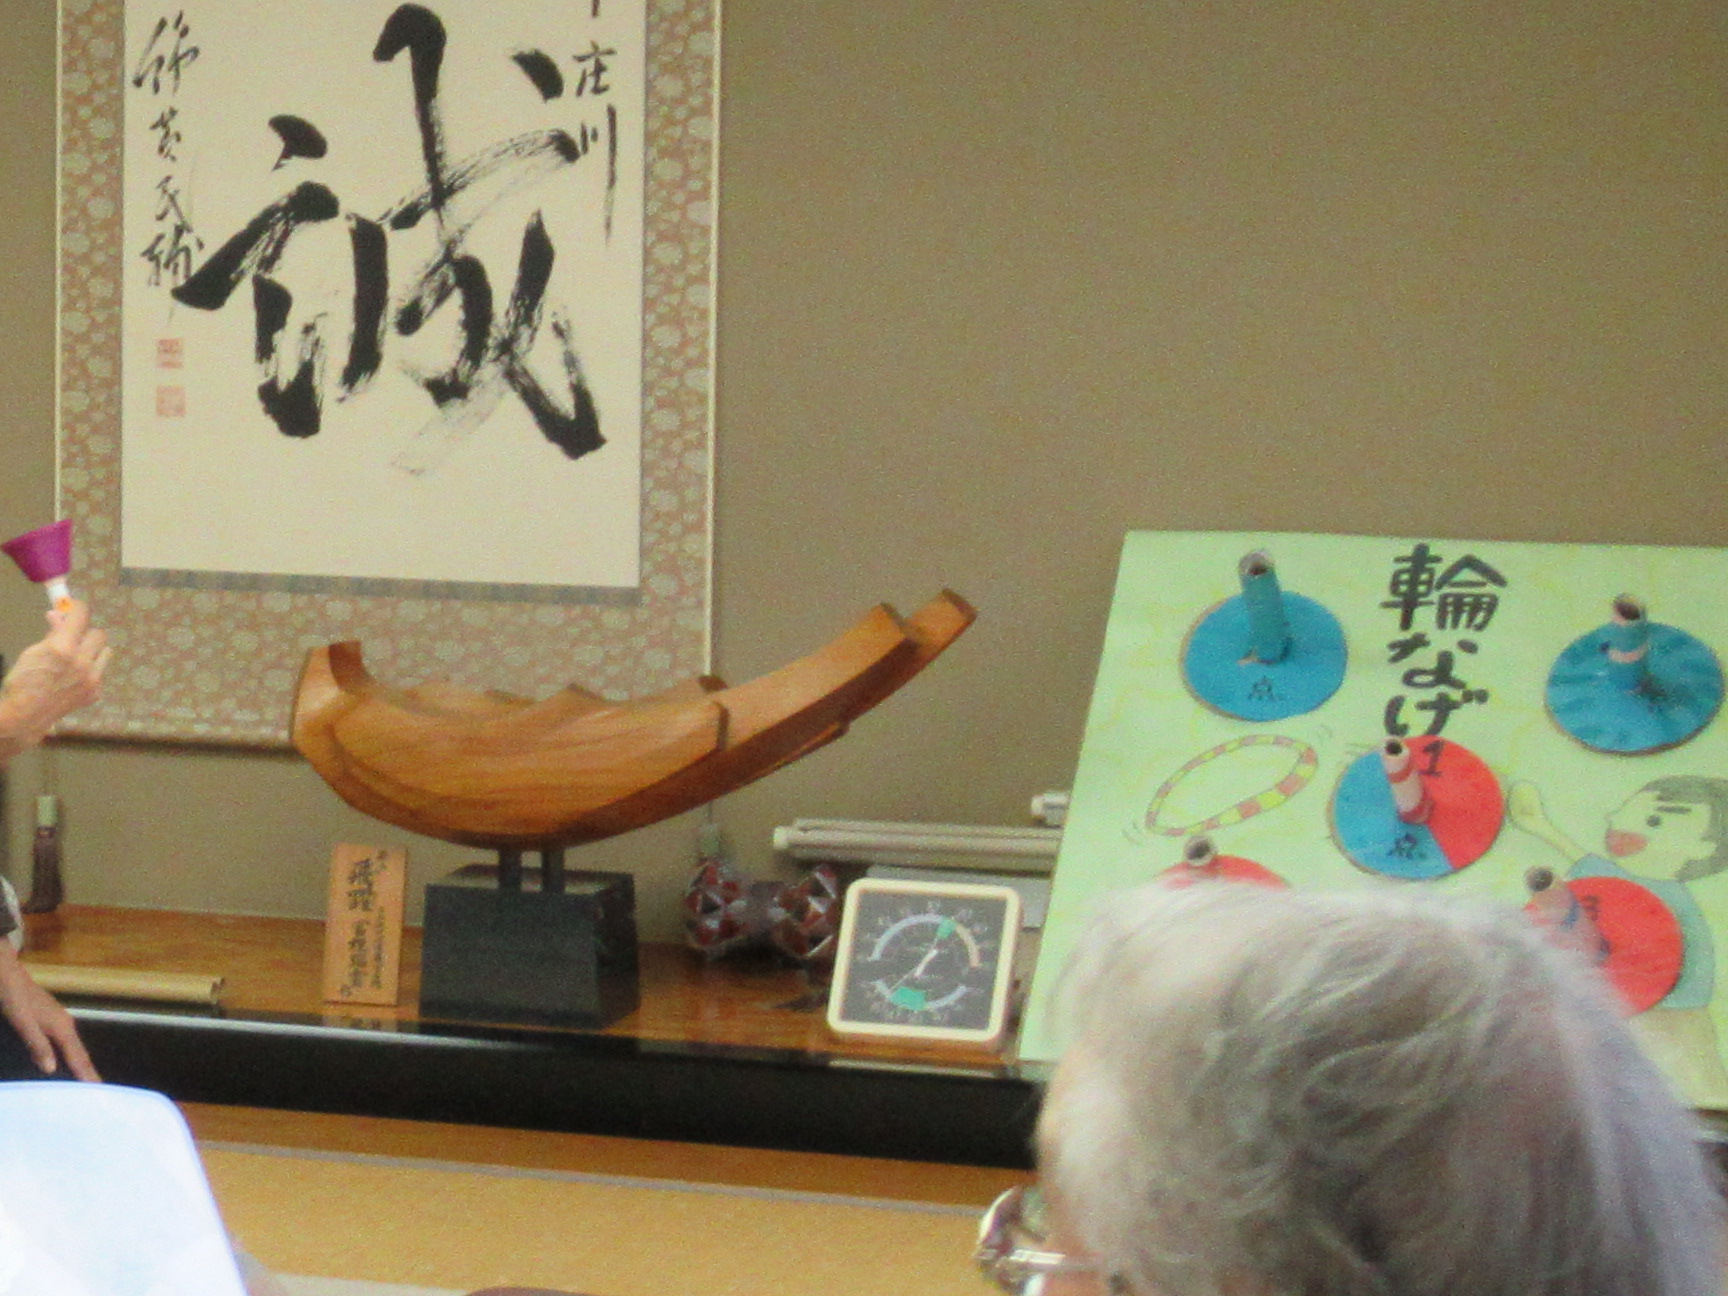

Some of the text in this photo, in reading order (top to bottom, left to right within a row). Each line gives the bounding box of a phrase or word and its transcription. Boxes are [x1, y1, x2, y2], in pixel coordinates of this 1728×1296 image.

[1380, 543, 1507, 735] 輪なげ
[1419, 740, 1444, 776] 1
